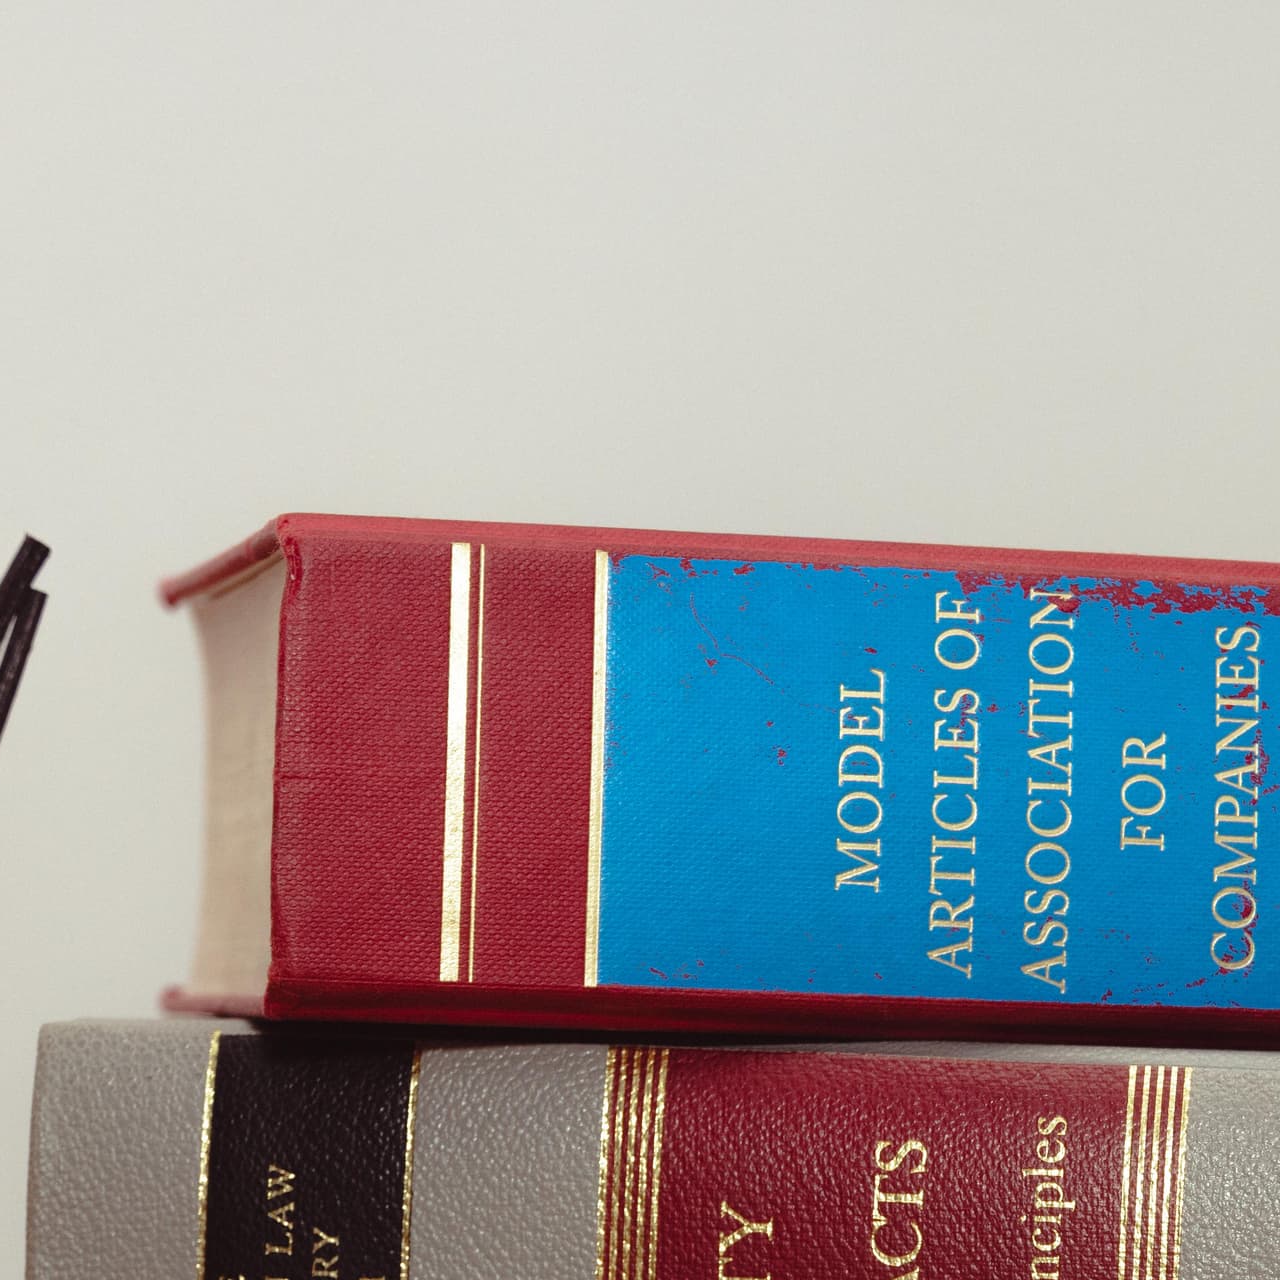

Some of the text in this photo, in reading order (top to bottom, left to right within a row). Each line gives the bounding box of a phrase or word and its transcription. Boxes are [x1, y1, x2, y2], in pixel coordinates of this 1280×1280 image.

[835, 668, 886, 893] MODEL
[927, 590, 983, 980] ARTICLES OF
[1021, 588, 1075, 995] ASSOCIATION
[1120, 732, 1168, 852] FOR
[1210, 625, 1261, 972] COMPANIES
[264, 1164, 297, 1256] LAW
